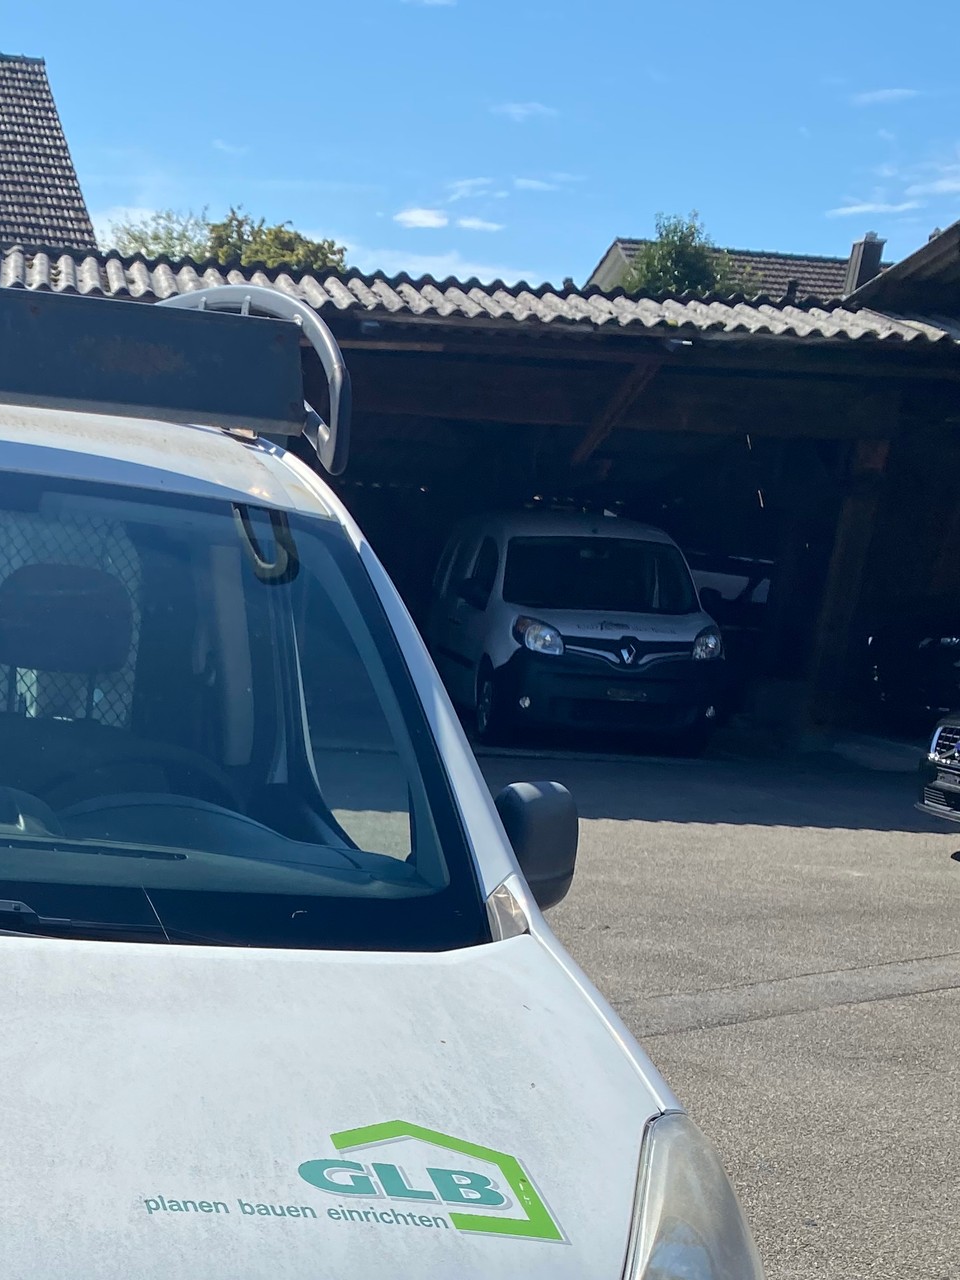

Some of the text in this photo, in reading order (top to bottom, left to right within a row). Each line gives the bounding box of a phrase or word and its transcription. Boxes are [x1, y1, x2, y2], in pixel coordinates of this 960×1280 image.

[297, 1158, 507, 1207] GLB
[144, 1195, 450, 1230] planen bauen einrichten
